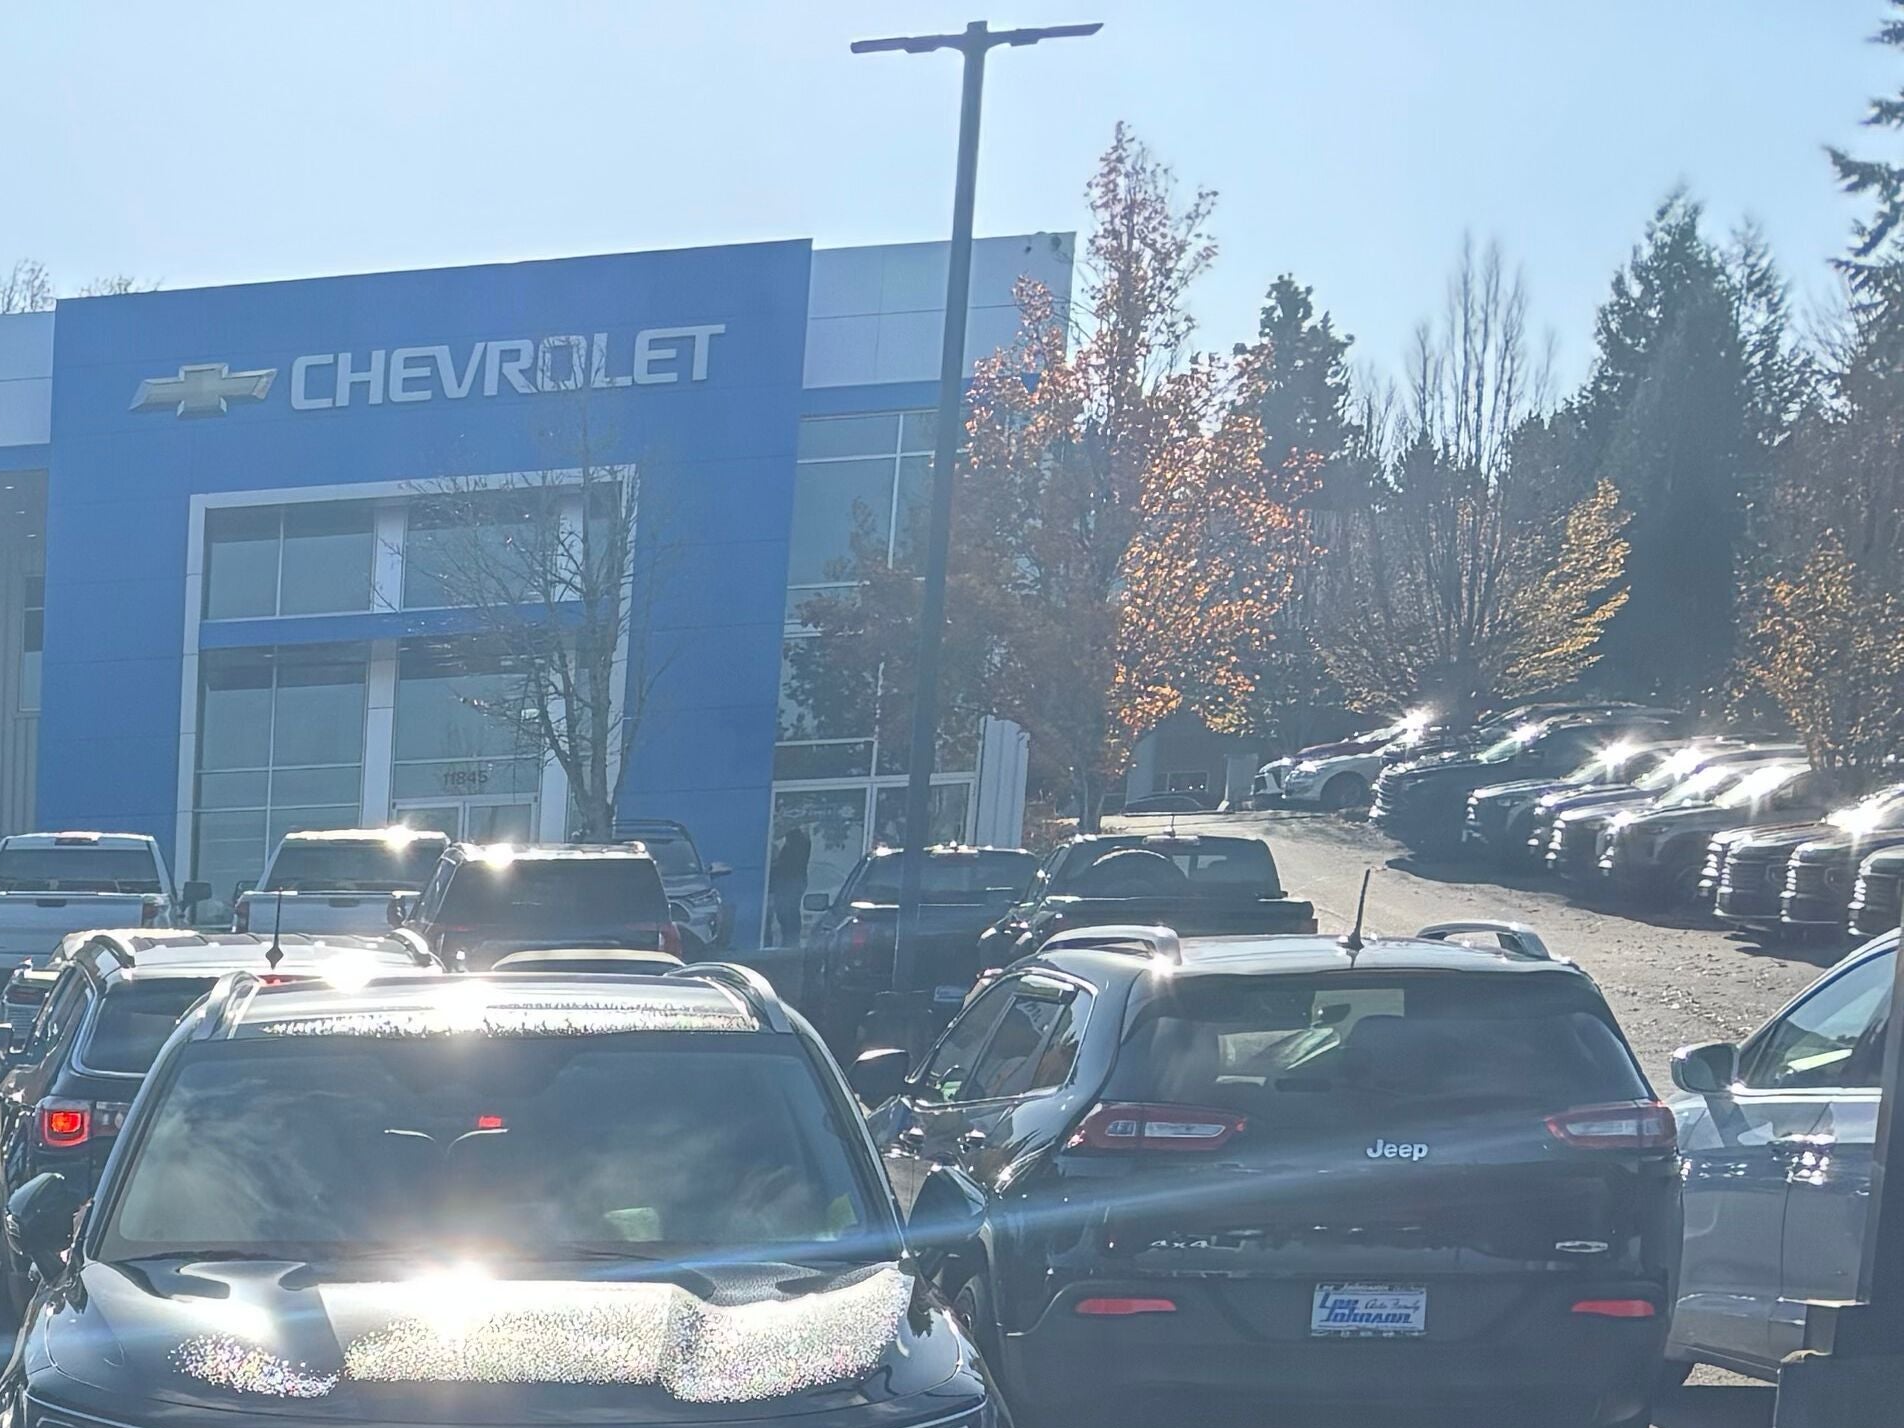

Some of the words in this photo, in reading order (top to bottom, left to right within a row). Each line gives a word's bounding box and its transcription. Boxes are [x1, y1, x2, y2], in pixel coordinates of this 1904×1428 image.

[291, 324, 727, 410] CHEVROLET
[1366, 1139, 1428, 1161] Jeep
[1319, 1292, 1360, 1310] Lee
